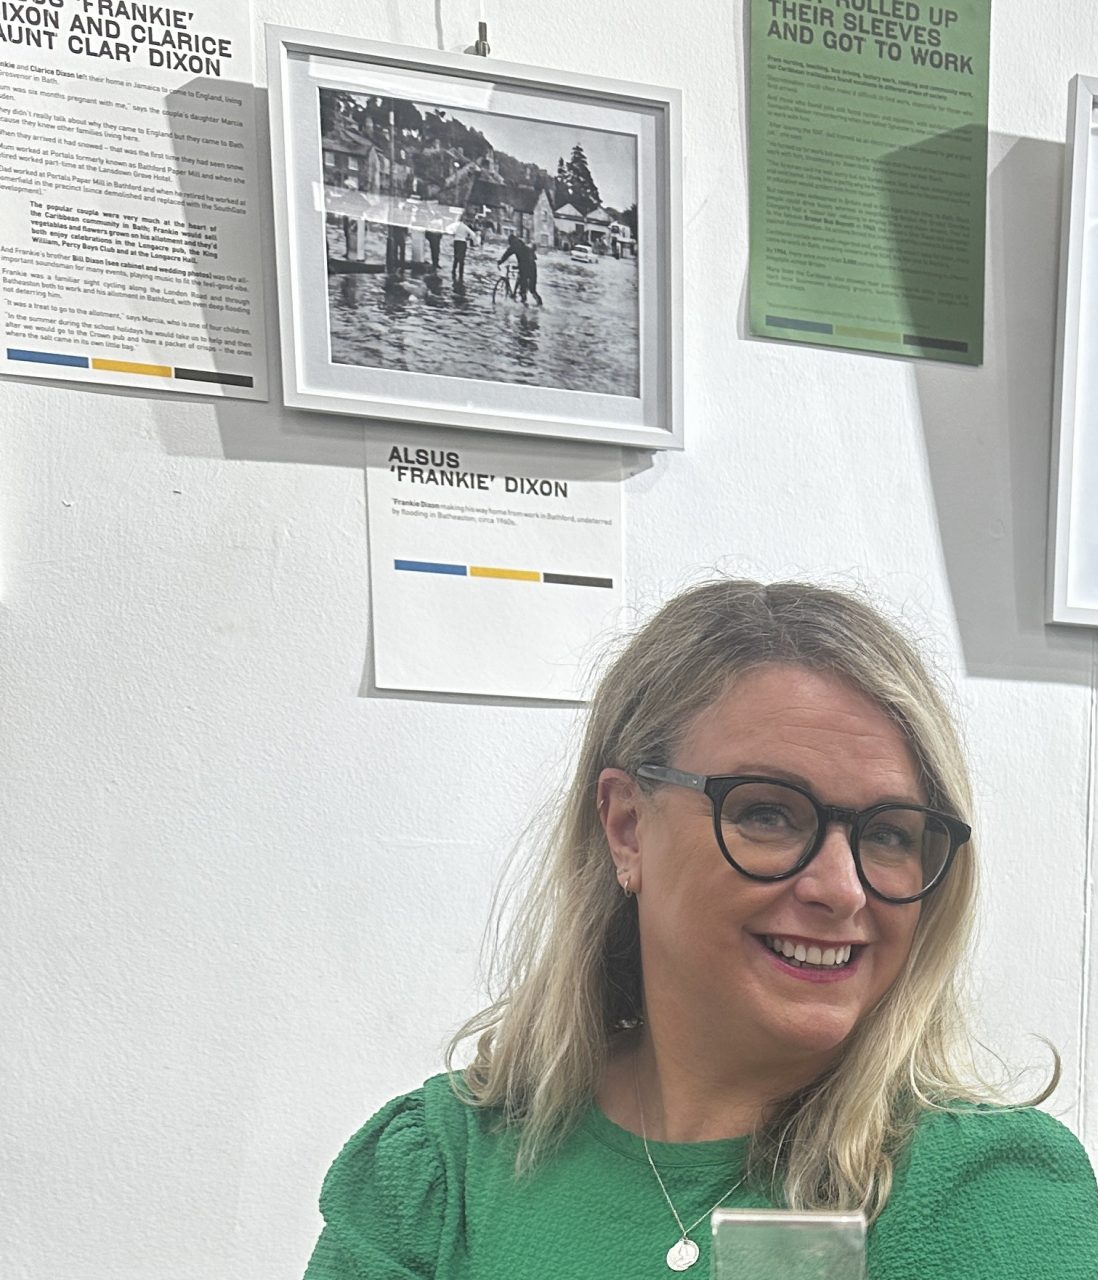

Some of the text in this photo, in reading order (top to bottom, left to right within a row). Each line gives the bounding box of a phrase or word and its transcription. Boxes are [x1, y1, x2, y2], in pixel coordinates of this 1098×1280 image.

[0, 1, 232, 58] IXON AND CLARICE
[77, 0, 193, 29] FRANKIE'
[768, 0, 941, 47] THEIR SLEEVES
[929, 7, 959, 27] UP
[68, 35, 138, 62] CLAR'
[149, 48, 220, 77] DIXON
[768, 19, 814, 45] AND
[823, 30, 867, 55] GOT
[874, 39, 902, 61] TO
[911, 45, 973, 75] WORK
[30, 200, 42, 208] The
[47, 204, 73, 213] popular
[77, 208, 99, 216] couple
[123, 214, 138, 222] very
[45, 212, 79, 221] Caribbean
[82, 218, 119, 228] community
[153, 226, 178, 235] Frankie
[388, 446, 460, 468] ALSUS
[390, 465, 568, 498] 'FRANKIE' DIXON
